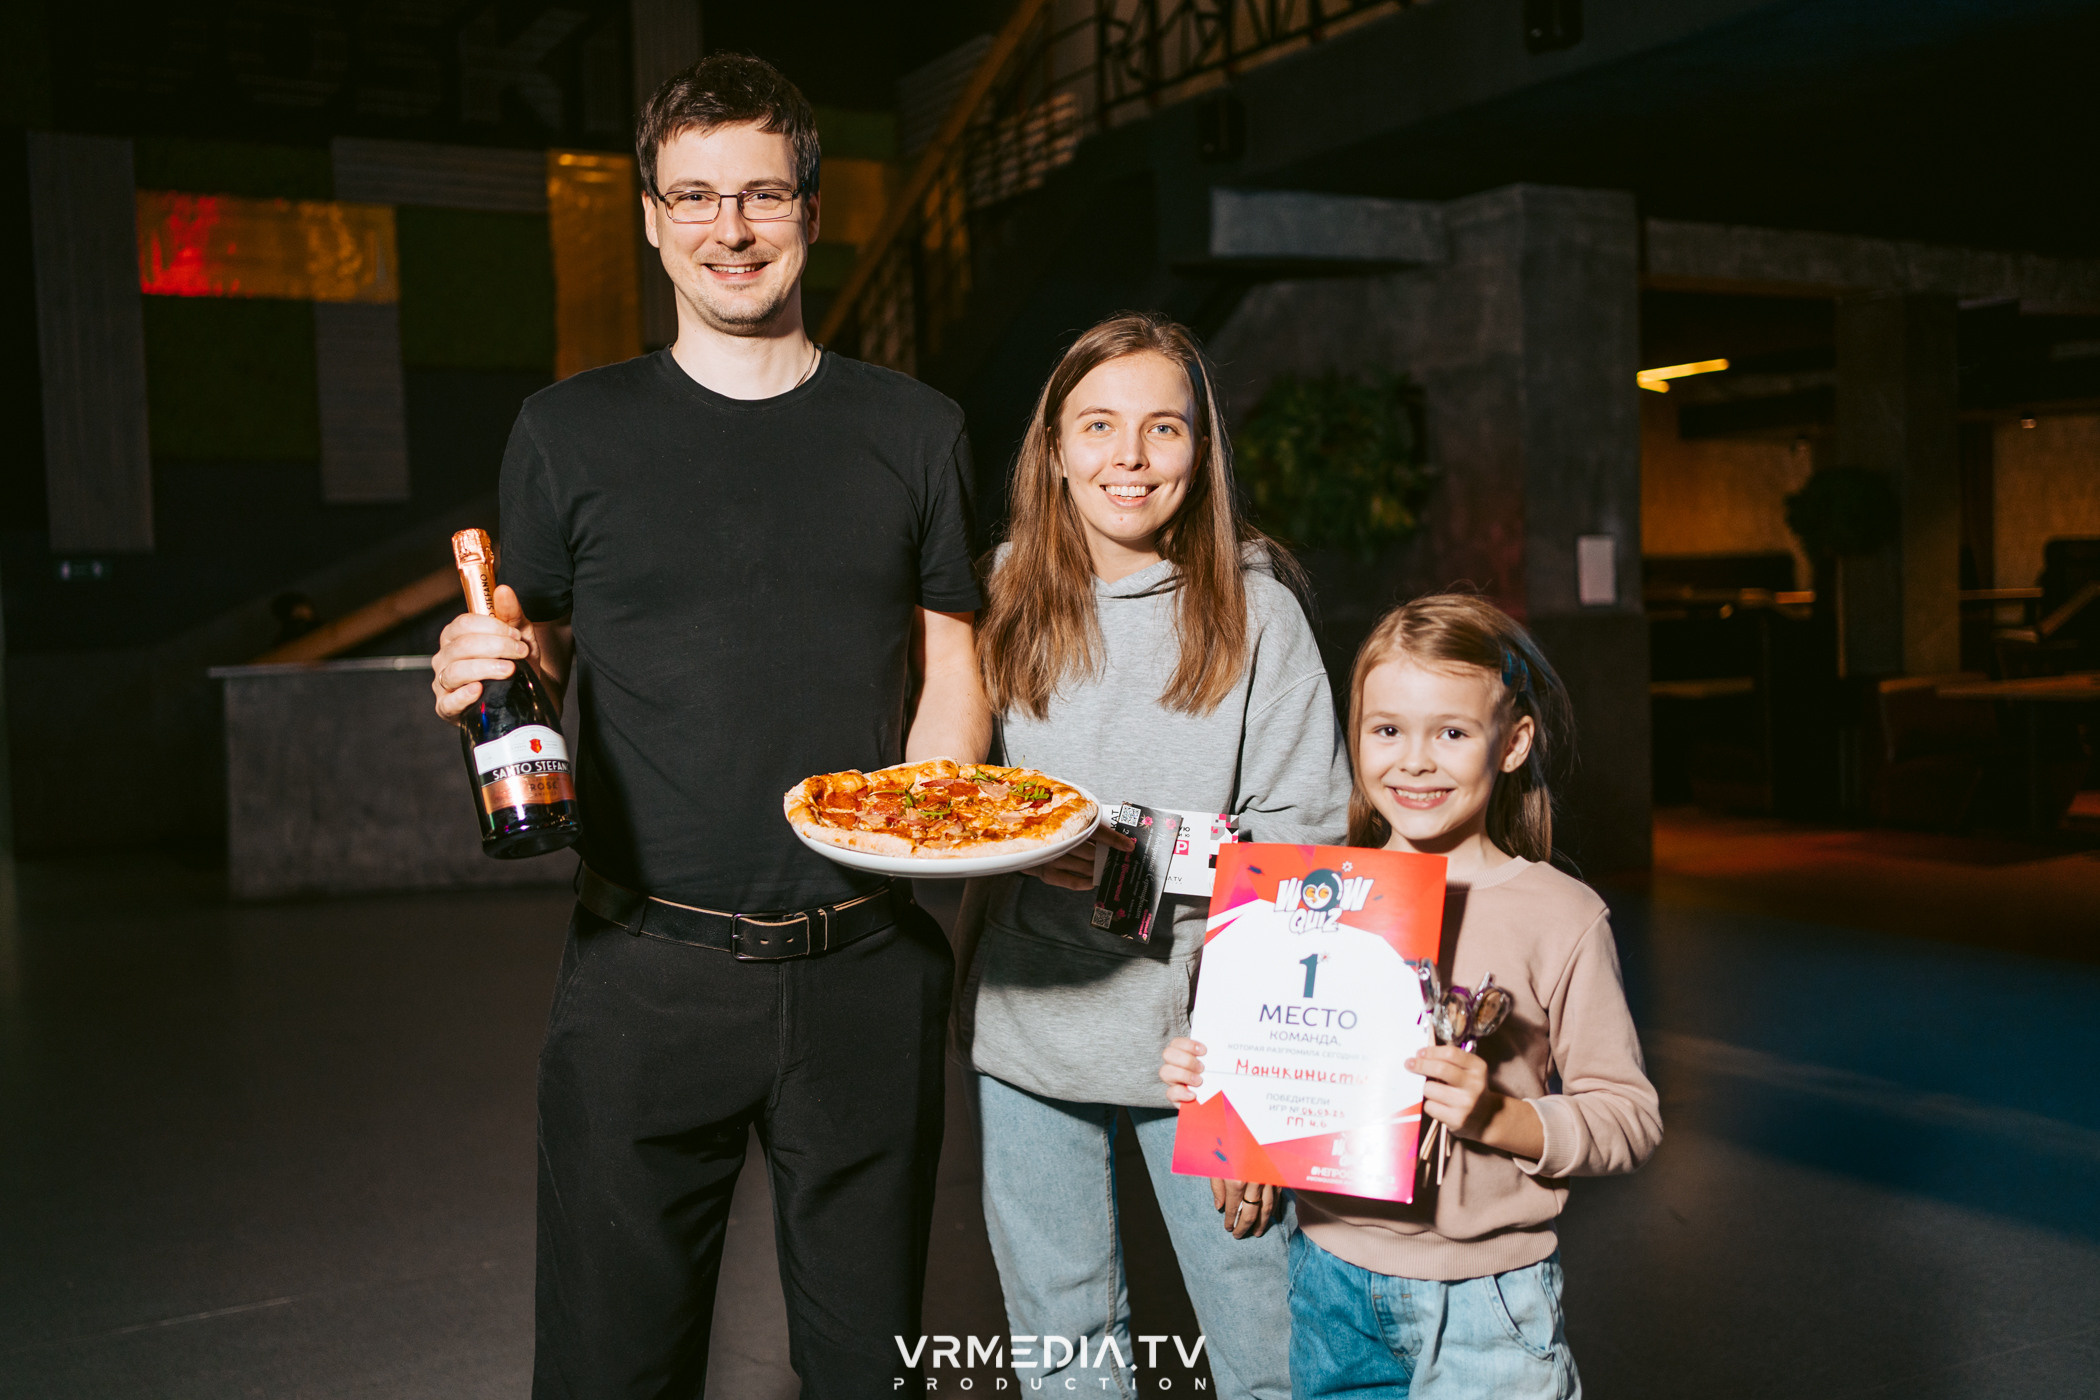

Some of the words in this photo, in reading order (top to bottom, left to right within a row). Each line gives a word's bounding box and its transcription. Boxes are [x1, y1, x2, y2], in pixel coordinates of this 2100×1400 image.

[492, 761, 533, 781] SANTO
[1289, 907, 1342, 934] QUIZ
[1299, 953, 1318, 998] 1
[1258, 1004, 1358, 1030] МЕСТО
[1227, 1043, 1265, 1052] КОТОРАЯ
[1266, 1047, 1320, 1057] РАЗГРОМИЛА
[1266, 1093, 1331, 1106] ПОБЕДИТЕЛИ
[1268, 1104, 1288, 1112] ИГР
